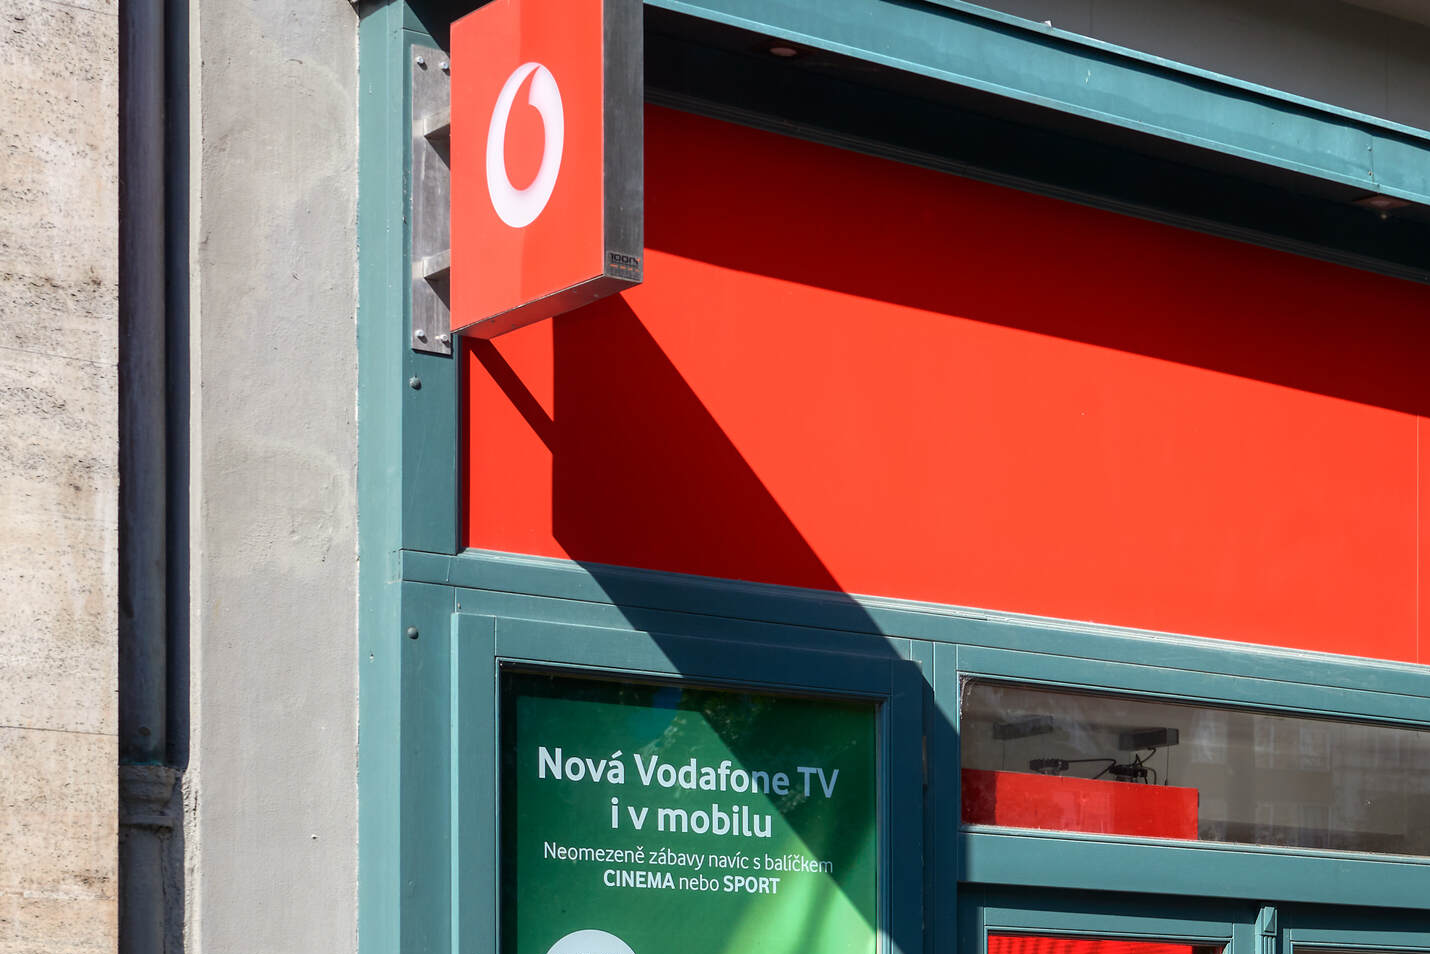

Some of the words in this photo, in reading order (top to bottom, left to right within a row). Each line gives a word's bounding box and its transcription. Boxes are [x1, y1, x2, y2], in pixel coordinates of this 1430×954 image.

[537, 746, 626, 785] Nová
[633, 753, 790, 796] Vodafone
[797, 766, 840, 798] TV
[610, 797, 619, 829] i
[627, 806, 649, 830] v
[657, 803, 772, 838] mobilu
[543, 841, 645, 864] Neomezeně
[649, 846, 705, 871] zábavy
[708, 850, 749, 870] navíc
[753, 857, 761, 871] s
[764, 853, 833, 873] balíčkem
[603, 869, 675, 890] CINEMA
[679, 873, 720, 892] nebo
[723, 876, 781, 894] SPORT
